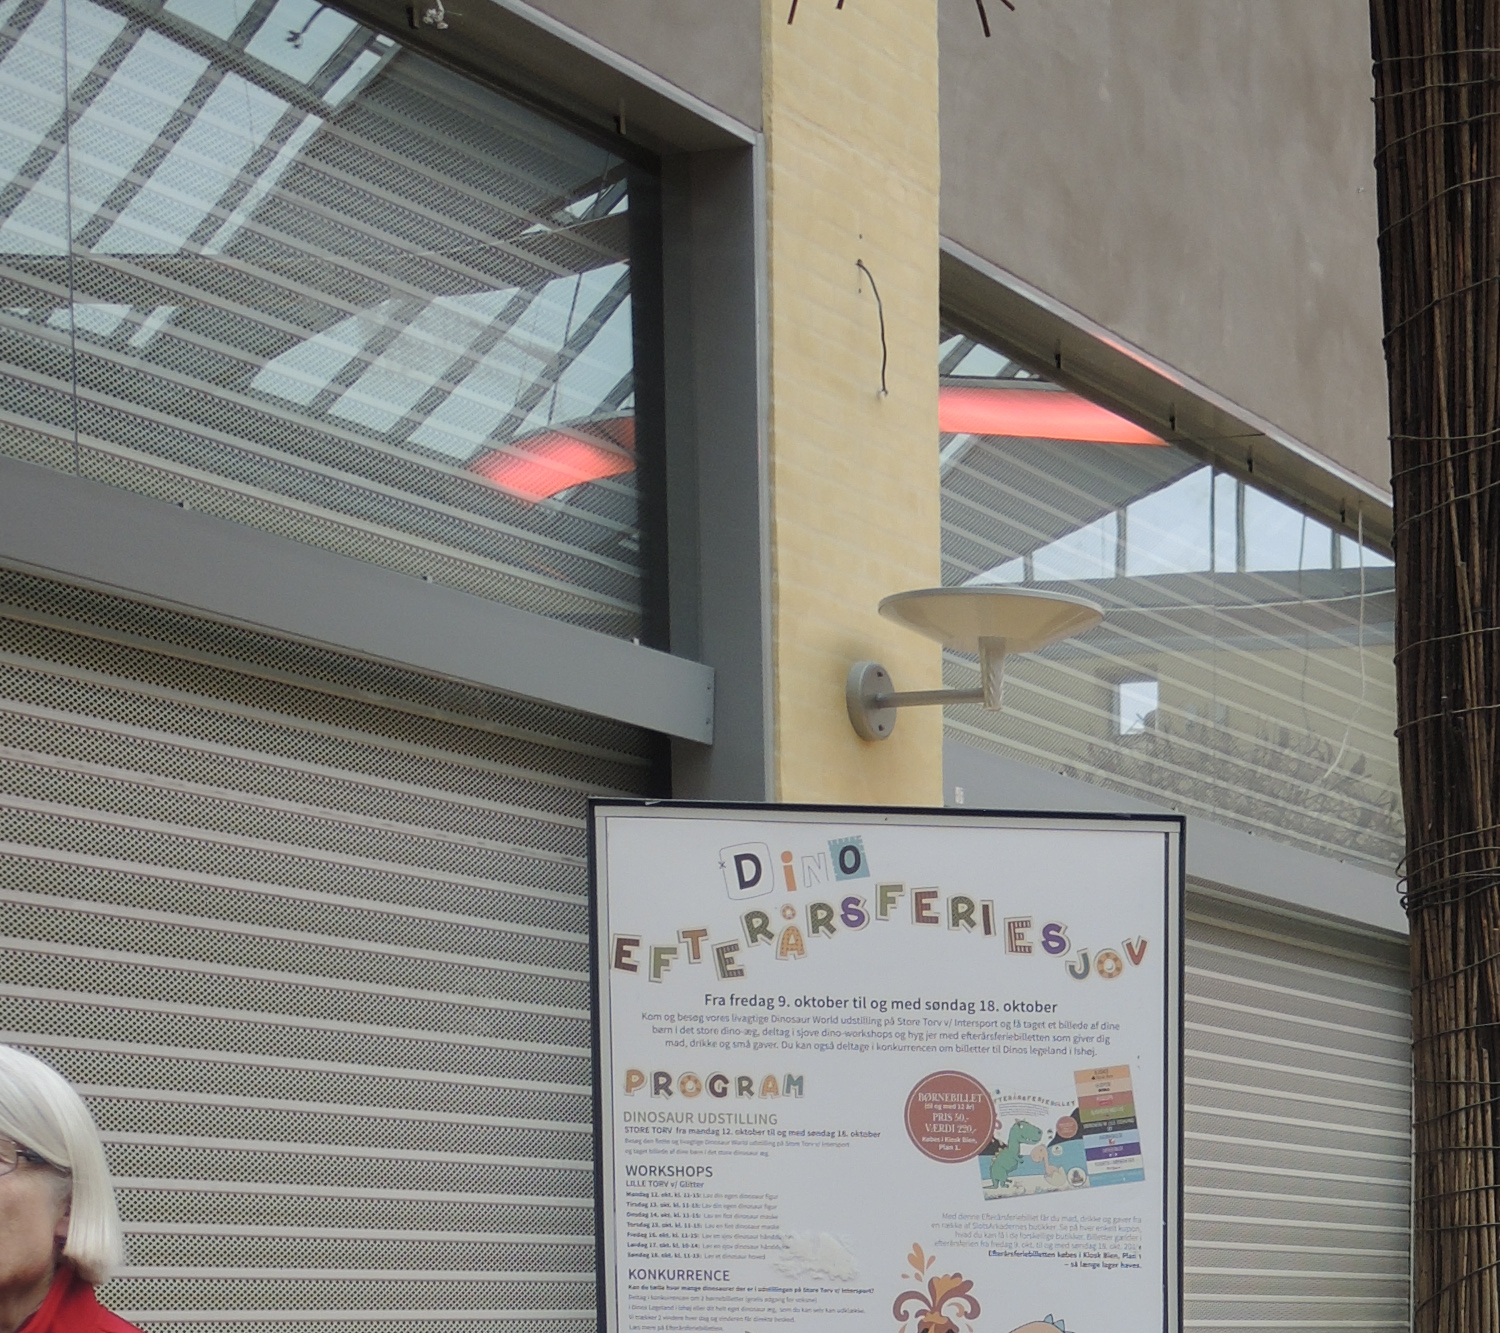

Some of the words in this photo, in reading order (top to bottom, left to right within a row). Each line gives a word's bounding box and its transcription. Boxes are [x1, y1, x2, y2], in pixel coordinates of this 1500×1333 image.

[734, 845, 861, 892] DINO
[705, 994, 725, 1007] Fra
[730, 994, 774, 1010] fredag
[778, 996, 790, 1007] 9.
[794, 995, 849, 1009] oktober
[853, 996, 867, 1009] til
[871, 1000, 887, 1012] og
[891, 998, 921, 1010] med
[925, 999, 975, 1014] søndag
[979, 1000, 999, 1012] 18.
[1003, 1000, 1058, 1013] oktober
[642, 1013, 662, 1021] Kom
[677, 1013, 704, 1023] besøg
[771, 1015, 810, 1023] Dinosaur
[813, 1015, 838, 1024] World
[841, 1016, 882, 1026] udstilling
[897, 1018, 920, 1026] Store
[923, 1018, 942, 1026] Torv
[954, 1018, 998, 1029] Intersport
[1101, 1021, 1120, 1030] dine
[624, 1069, 804, 1098] PROGRAM
[623, 1112, 694, 1124] DINOSAUR
[698, 1113, 778, 1125] UDSTILLING
[933, 1113, 953, 1121] PRIS
[652, 1127, 672, 1135] TORV
[735, 1128, 764, 1136] oktober
[625, 1165, 713, 1177] WORKSHOPS
[628, 1268, 730, 1281] KONKURRENCE
